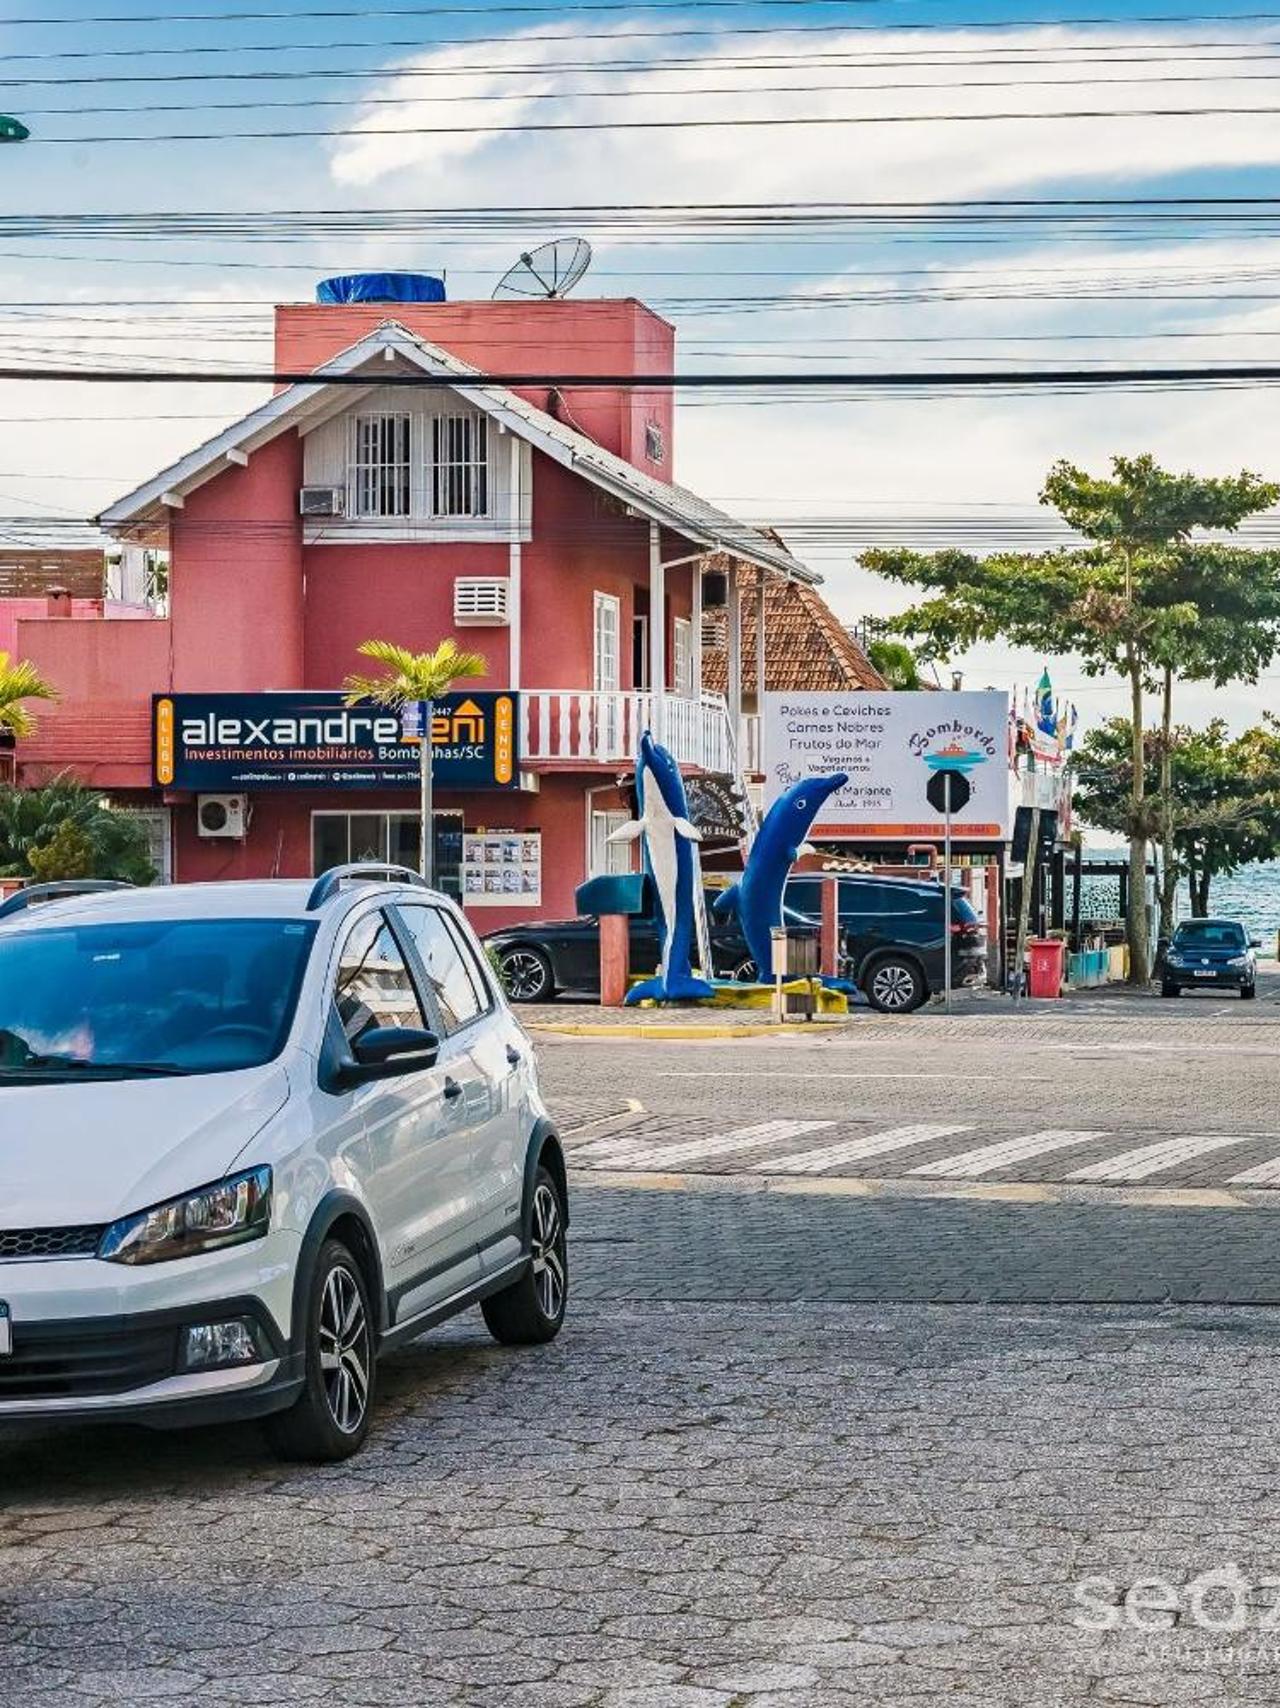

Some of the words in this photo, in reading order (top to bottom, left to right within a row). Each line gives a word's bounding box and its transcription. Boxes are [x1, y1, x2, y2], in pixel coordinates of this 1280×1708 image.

[822, 707, 830, 716] e
[833, 705, 892, 716] Ceviches
[182, 712, 398, 744] alexandre
[786, 721, 834, 733] Carnes
[837, 721, 884, 733] Nobres
[500, 705, 508, 774] VENDE
[789, 738, 832, 750] Frutos
[835, 738, 853, 750] do
[856, 738, 882, 749] Mar
[909, 719, 996, 757] Bombordo
[185, 746, 285, 761] Investimentos
[289, 745, 374, 761] imobiliários
[842, 786, 892, 796] Mariante
